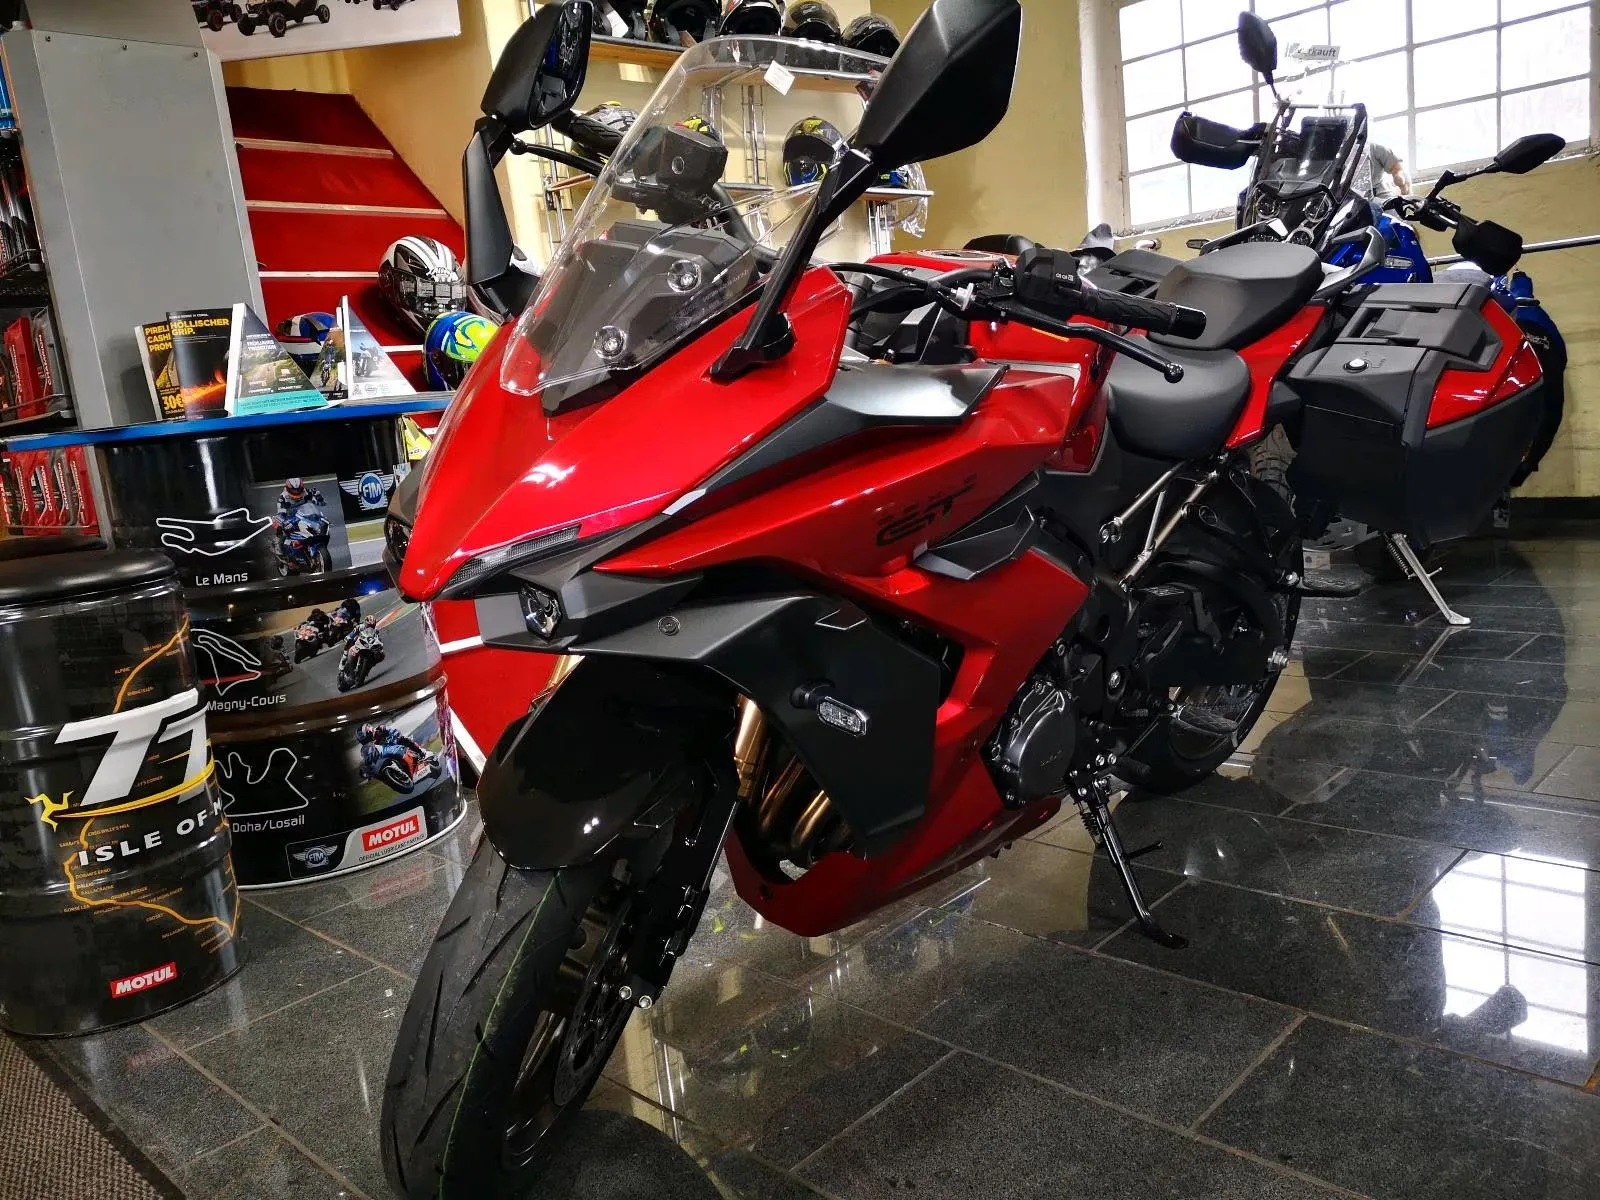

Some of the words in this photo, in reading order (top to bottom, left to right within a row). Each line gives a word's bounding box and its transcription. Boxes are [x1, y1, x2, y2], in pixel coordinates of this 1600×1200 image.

[170, 319, 229, 329] HÖLLISCHER
[171, 327, 196, 336] GRIP.
[149, 342, 173, 352] PROM
[162, 394, 184, 410] 30€
[40, 465, 53, 511] CHAMPION
[362, 482, 381, 499] FIM
[195, 575, 210, 586] Le
[213, 572, 248, 585] Mans
[207, 694, 287, 712] Magny-Cours
[232, 814, 305, 833] Doha/Losail
[78, 830, 162, 867] ISLE
[176, 809, 209, 836] OF
[368, 820, 417, 847] MOTUL
[308, 852, 324, 862] FIM
[115, 966, 174, 995] MOTUL
